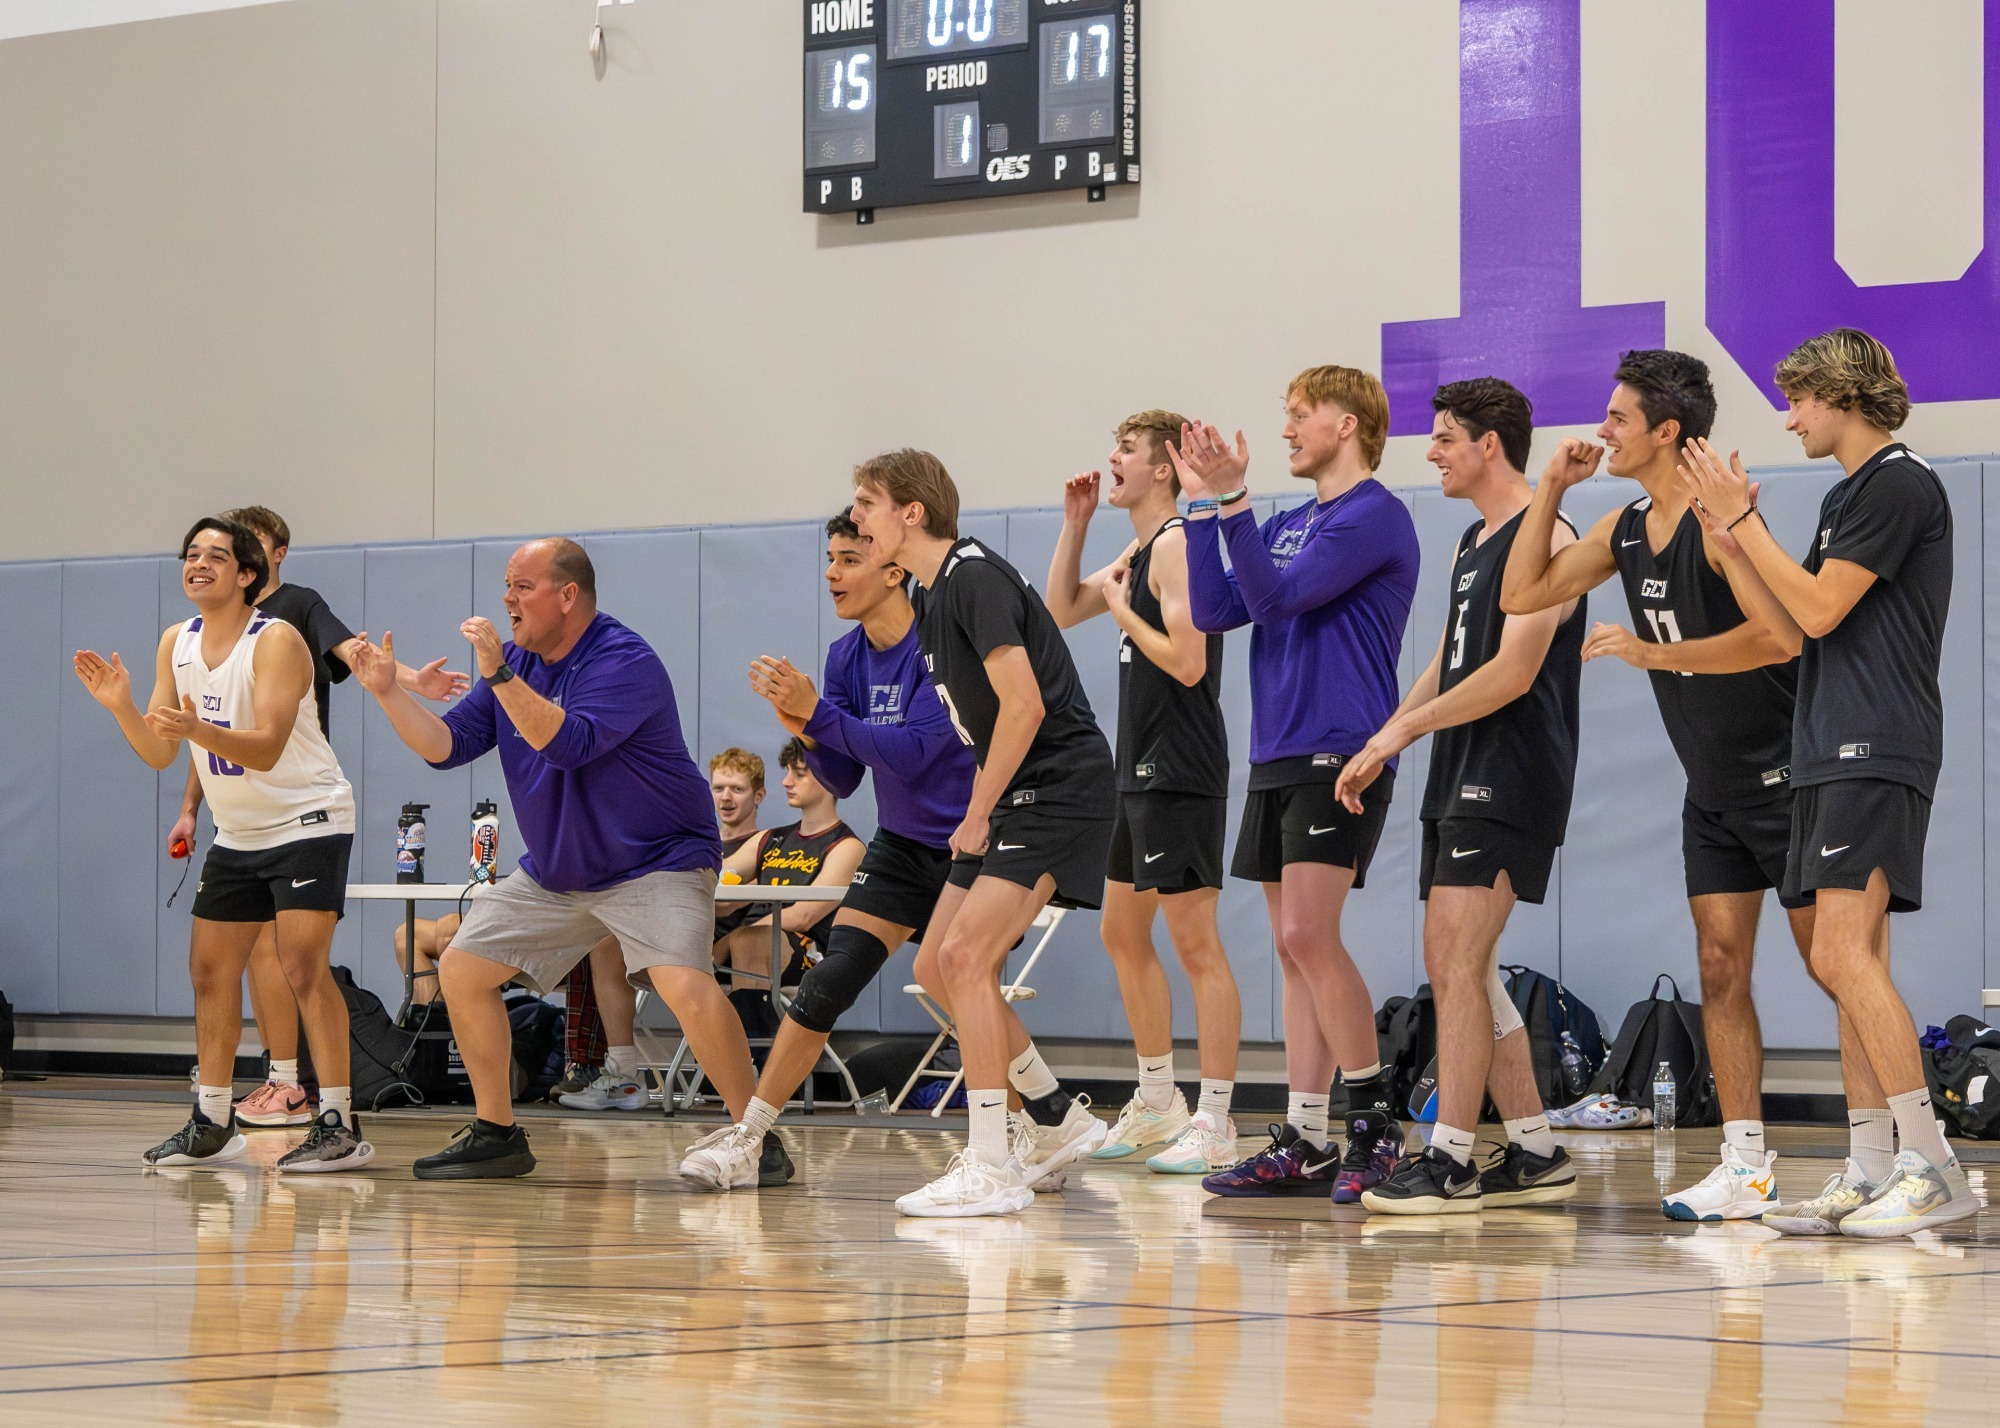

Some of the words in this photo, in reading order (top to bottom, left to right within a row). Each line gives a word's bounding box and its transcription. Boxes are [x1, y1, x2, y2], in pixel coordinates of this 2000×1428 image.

[811, 0, 874, 34] HOME
[1066, 24, 1109, 81] 17
[832, 54, 870, 110] 15
[926, 60, 988, 92] PERIOD
[962, 115, 971, 164] 1
[986, 154, 1031, 182] OES
[1055, 155, 1067, 180] P
[1088, 152, 1100, 177] B
[821, 180, 832, 204] P
[851, 177, 862, 201] B
[1641, 579, 1668, 598] GCU
[1449, 599, 1469, 671] 5
[1479, 790, 1488, 798] XL
